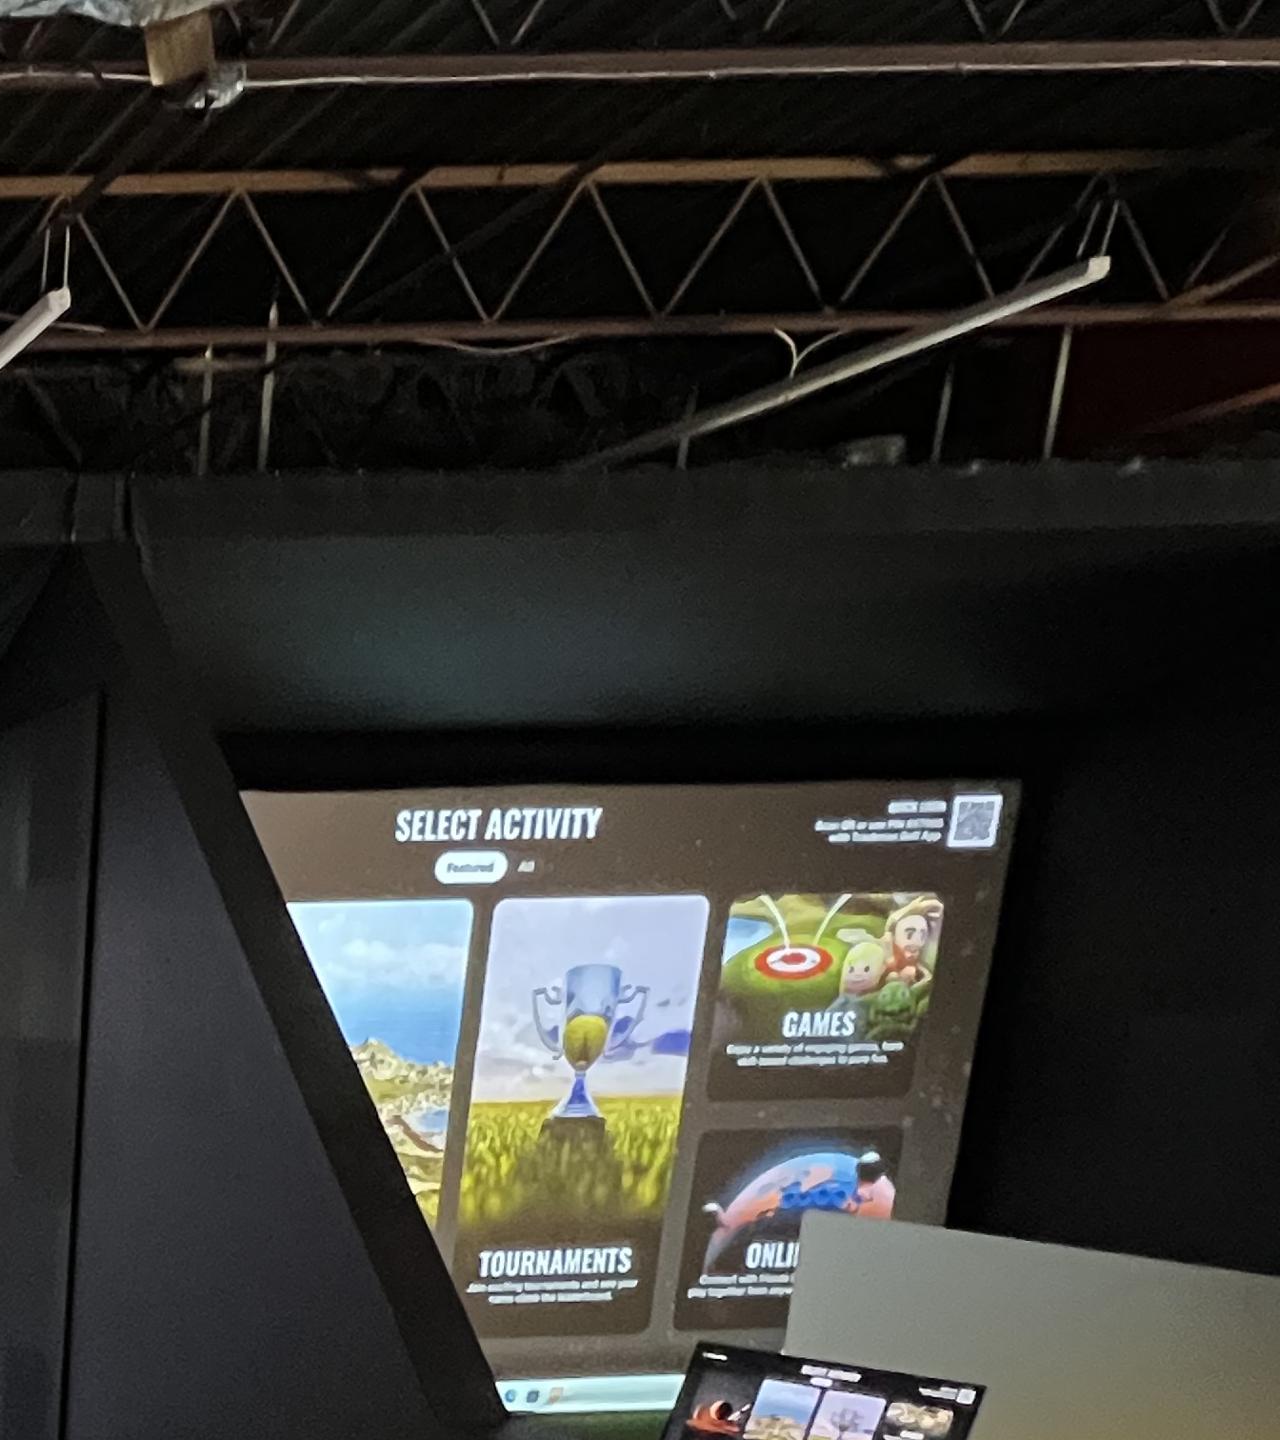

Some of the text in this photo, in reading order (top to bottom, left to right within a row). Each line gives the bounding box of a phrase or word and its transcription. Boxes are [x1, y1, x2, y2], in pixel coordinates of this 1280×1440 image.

[395, 807, 603, 842] SELECT ACTIVITY
[782, 1011, 857, 1038] GAMES
[479, 1247, 632, 1278] TOURNAMENTS
